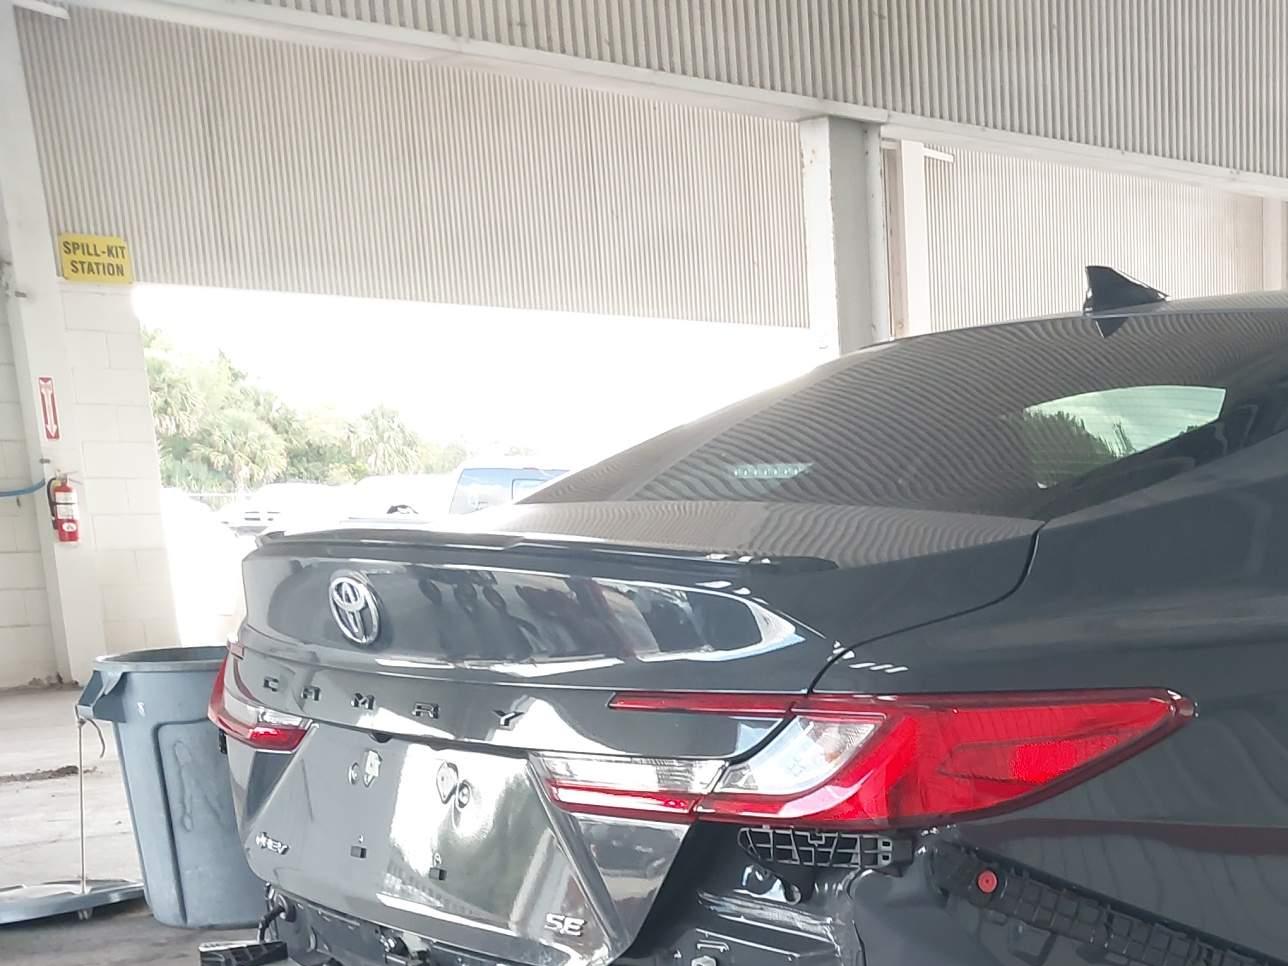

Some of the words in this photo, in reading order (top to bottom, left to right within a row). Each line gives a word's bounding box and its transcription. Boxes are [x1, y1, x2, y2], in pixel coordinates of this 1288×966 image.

[62, 241, 127, 259] SPILL-KIT
[70, 260, 125, 277] STATION
[263, 675, 525, 732] CAMRY
[544, 912, 587, 937] SE
